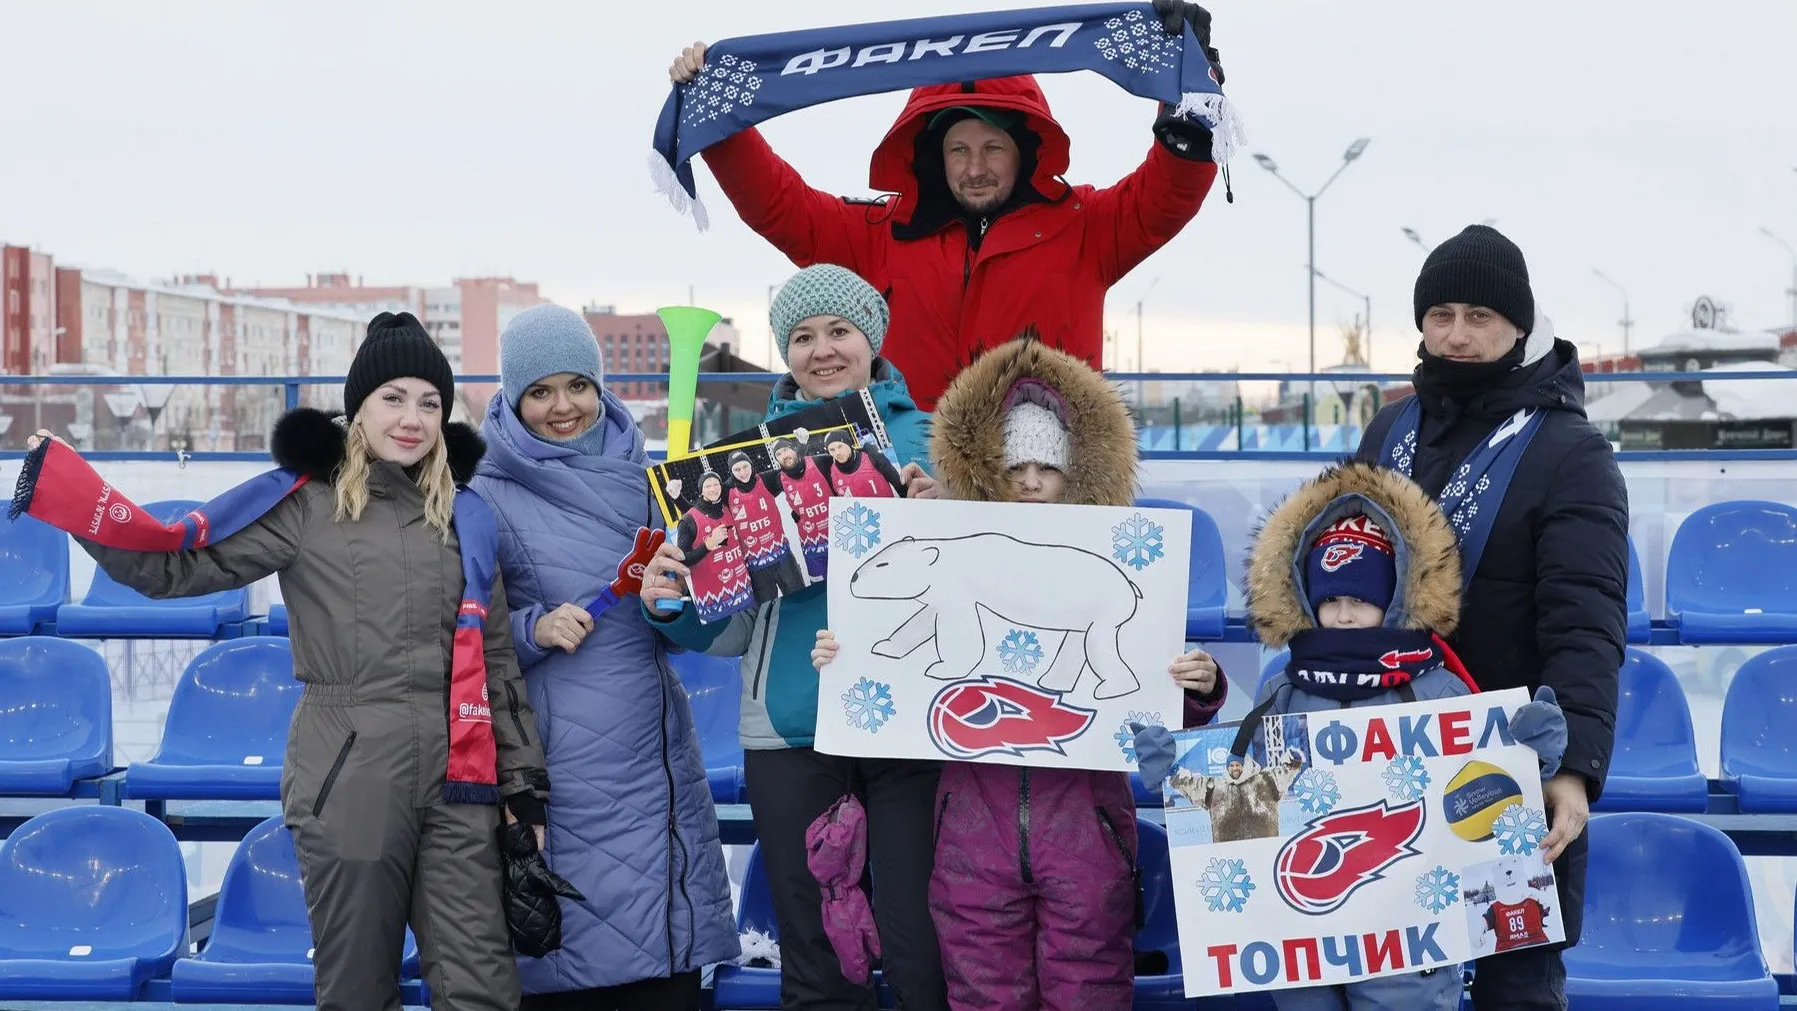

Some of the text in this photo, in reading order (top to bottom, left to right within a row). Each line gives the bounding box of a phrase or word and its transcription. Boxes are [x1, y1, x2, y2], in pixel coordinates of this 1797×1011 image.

[780, 21, 1083, 77] ФАКЕЛ
[813, 482, 823, 497] 3
[868, 479, 878, 494] 1
[758, 496, 768, 511] 4
[805, 502, 828, 518] ВТБ
[749, 516, 771, 532] ВТБ
[725, 545, 743, 563] ВТБ
[1315, 705, 1515, 765] ФАКЕЛ
[1466, 786, 1487, 798] Snow
[1468, 787, 1503, 805] Volleyball
[1508, 915, 1525, 932] 89
[1207, 921, 1448, 989] ТОПЧИК
